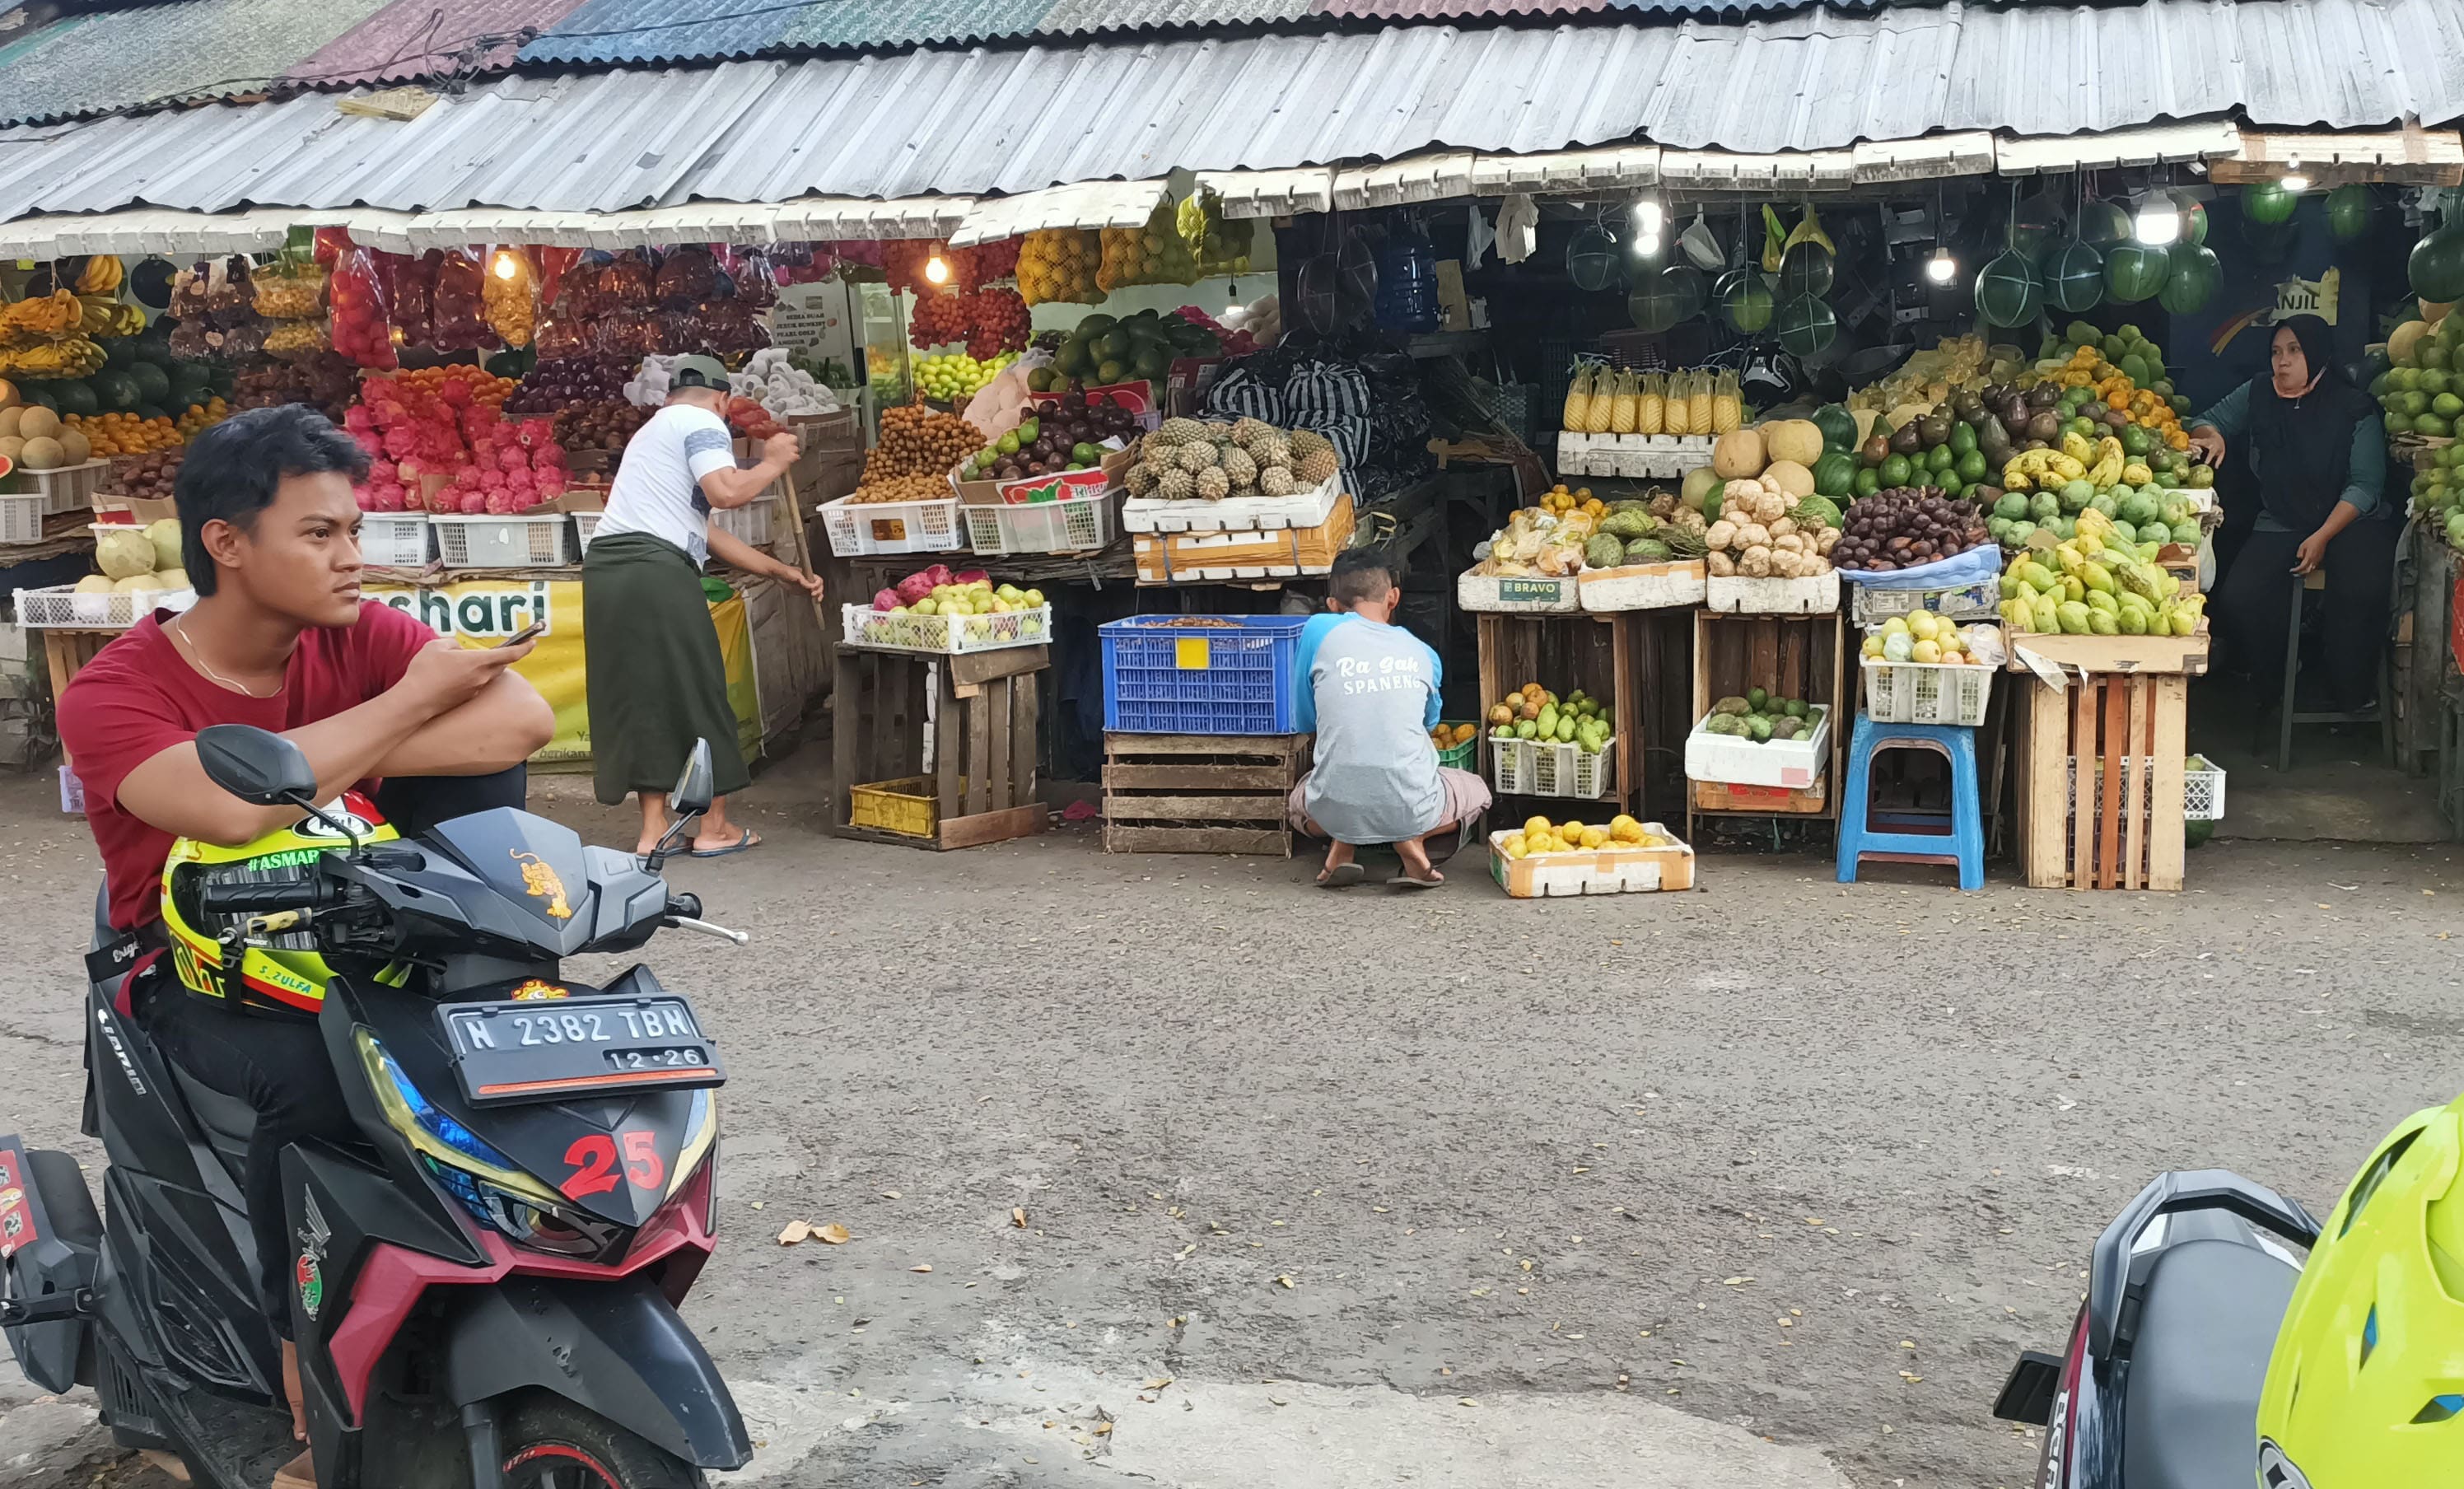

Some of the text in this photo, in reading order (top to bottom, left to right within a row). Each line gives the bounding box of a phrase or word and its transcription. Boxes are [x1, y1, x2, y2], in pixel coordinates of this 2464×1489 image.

[2276, 295, 2320, 310] NJIL
[1514, 581, 1556, 593] BRAVO
[360, 581, 545, 633] shari
[1336, 656, 1371, 678] Ra
[539, 747, 587, 759] berikan
[464, 1020, 495, 1049] N
[513, 1013, 611, 1046] 2382
[559, 1131, 665, 1202] 25
